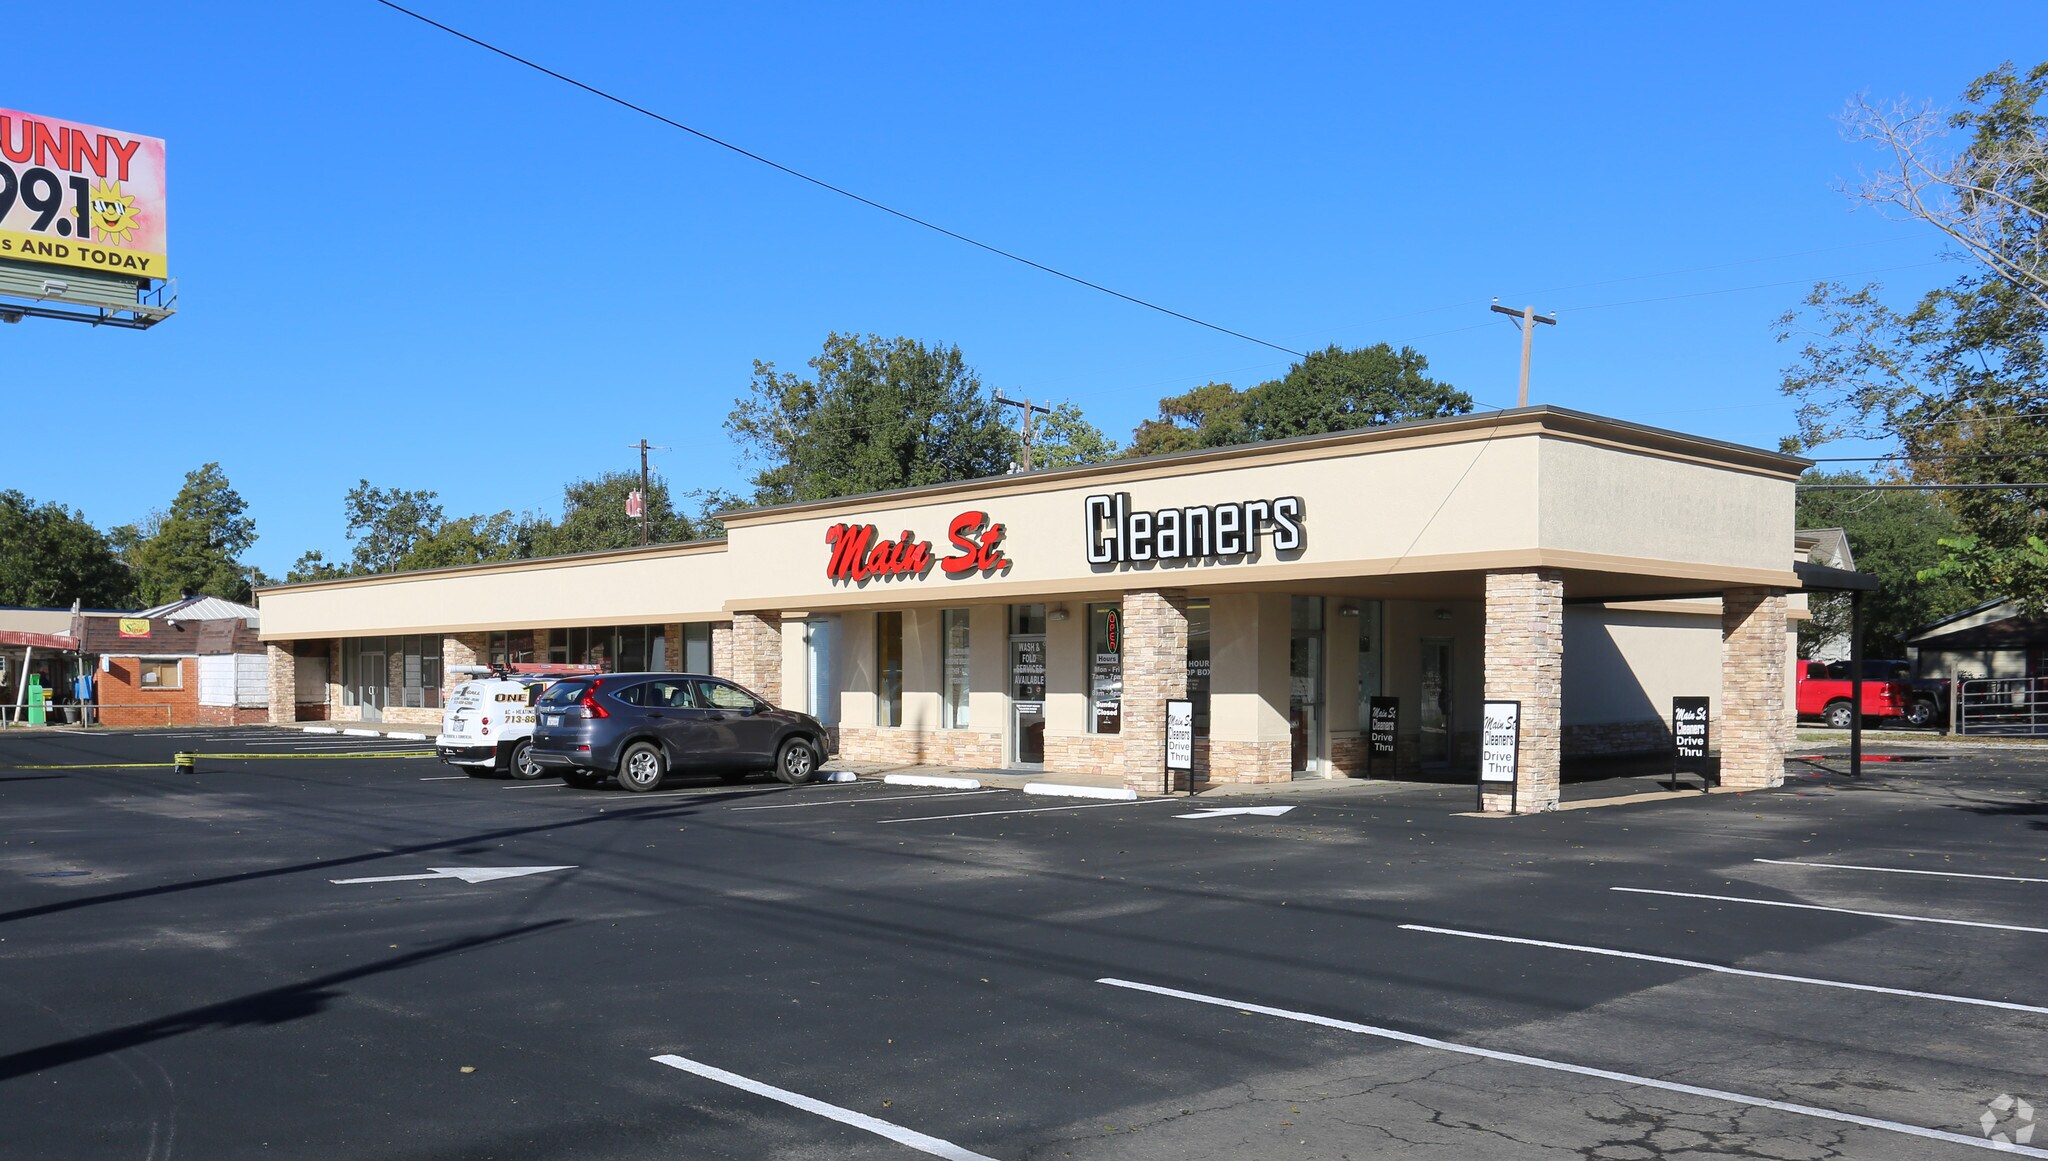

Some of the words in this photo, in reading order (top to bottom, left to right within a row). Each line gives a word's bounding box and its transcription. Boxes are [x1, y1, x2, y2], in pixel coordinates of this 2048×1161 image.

[0, 116, 141, 182] UNNY
[21, 239, 69, 258] AND
[78, 247, 150, 271] TODAY
[825, 522, 932, 583] Main
[941, 510, 1009, 574] St.
[1085, 492, 1301, 565] Cleaners
[1109, 613, 1117, 650] OPEN
[1018, 642, 1035, 652] WASH
[1022, 654, 1037, 663] FOLD
[1016, 664, 1043, 674] SERVICES
[1188, 660, 1210, 668] HOUR
[1014, 675, 1045, 685] AVAILABLE
[494, 693, 528, 703] ONE
[1096, 700, 1119, 709] Sunday
[1675, 707, 1696, 721] Main
[1695, 706, 1707, 721] St
[504, 715, 535, 724] 713-88
[1484, 716, 1505, 730] Main
[1676, 721, 1705, 735] Cleaners
[1371, 732, 1393, 741] Drive
[1484, 730, 1514, 746] Cleaners
[1676, 736, 1704, 746] Drive
[1168, 741, 1190, 751] Drive
[1374, 742, 1394, 752] Thru
[1483, 750, 1512, 761] Drive
[1677, 746, 1703, 757] Thru
[1170, 752, 1189, 762] Thru
[1488, 762, 1514, 773] Thru
